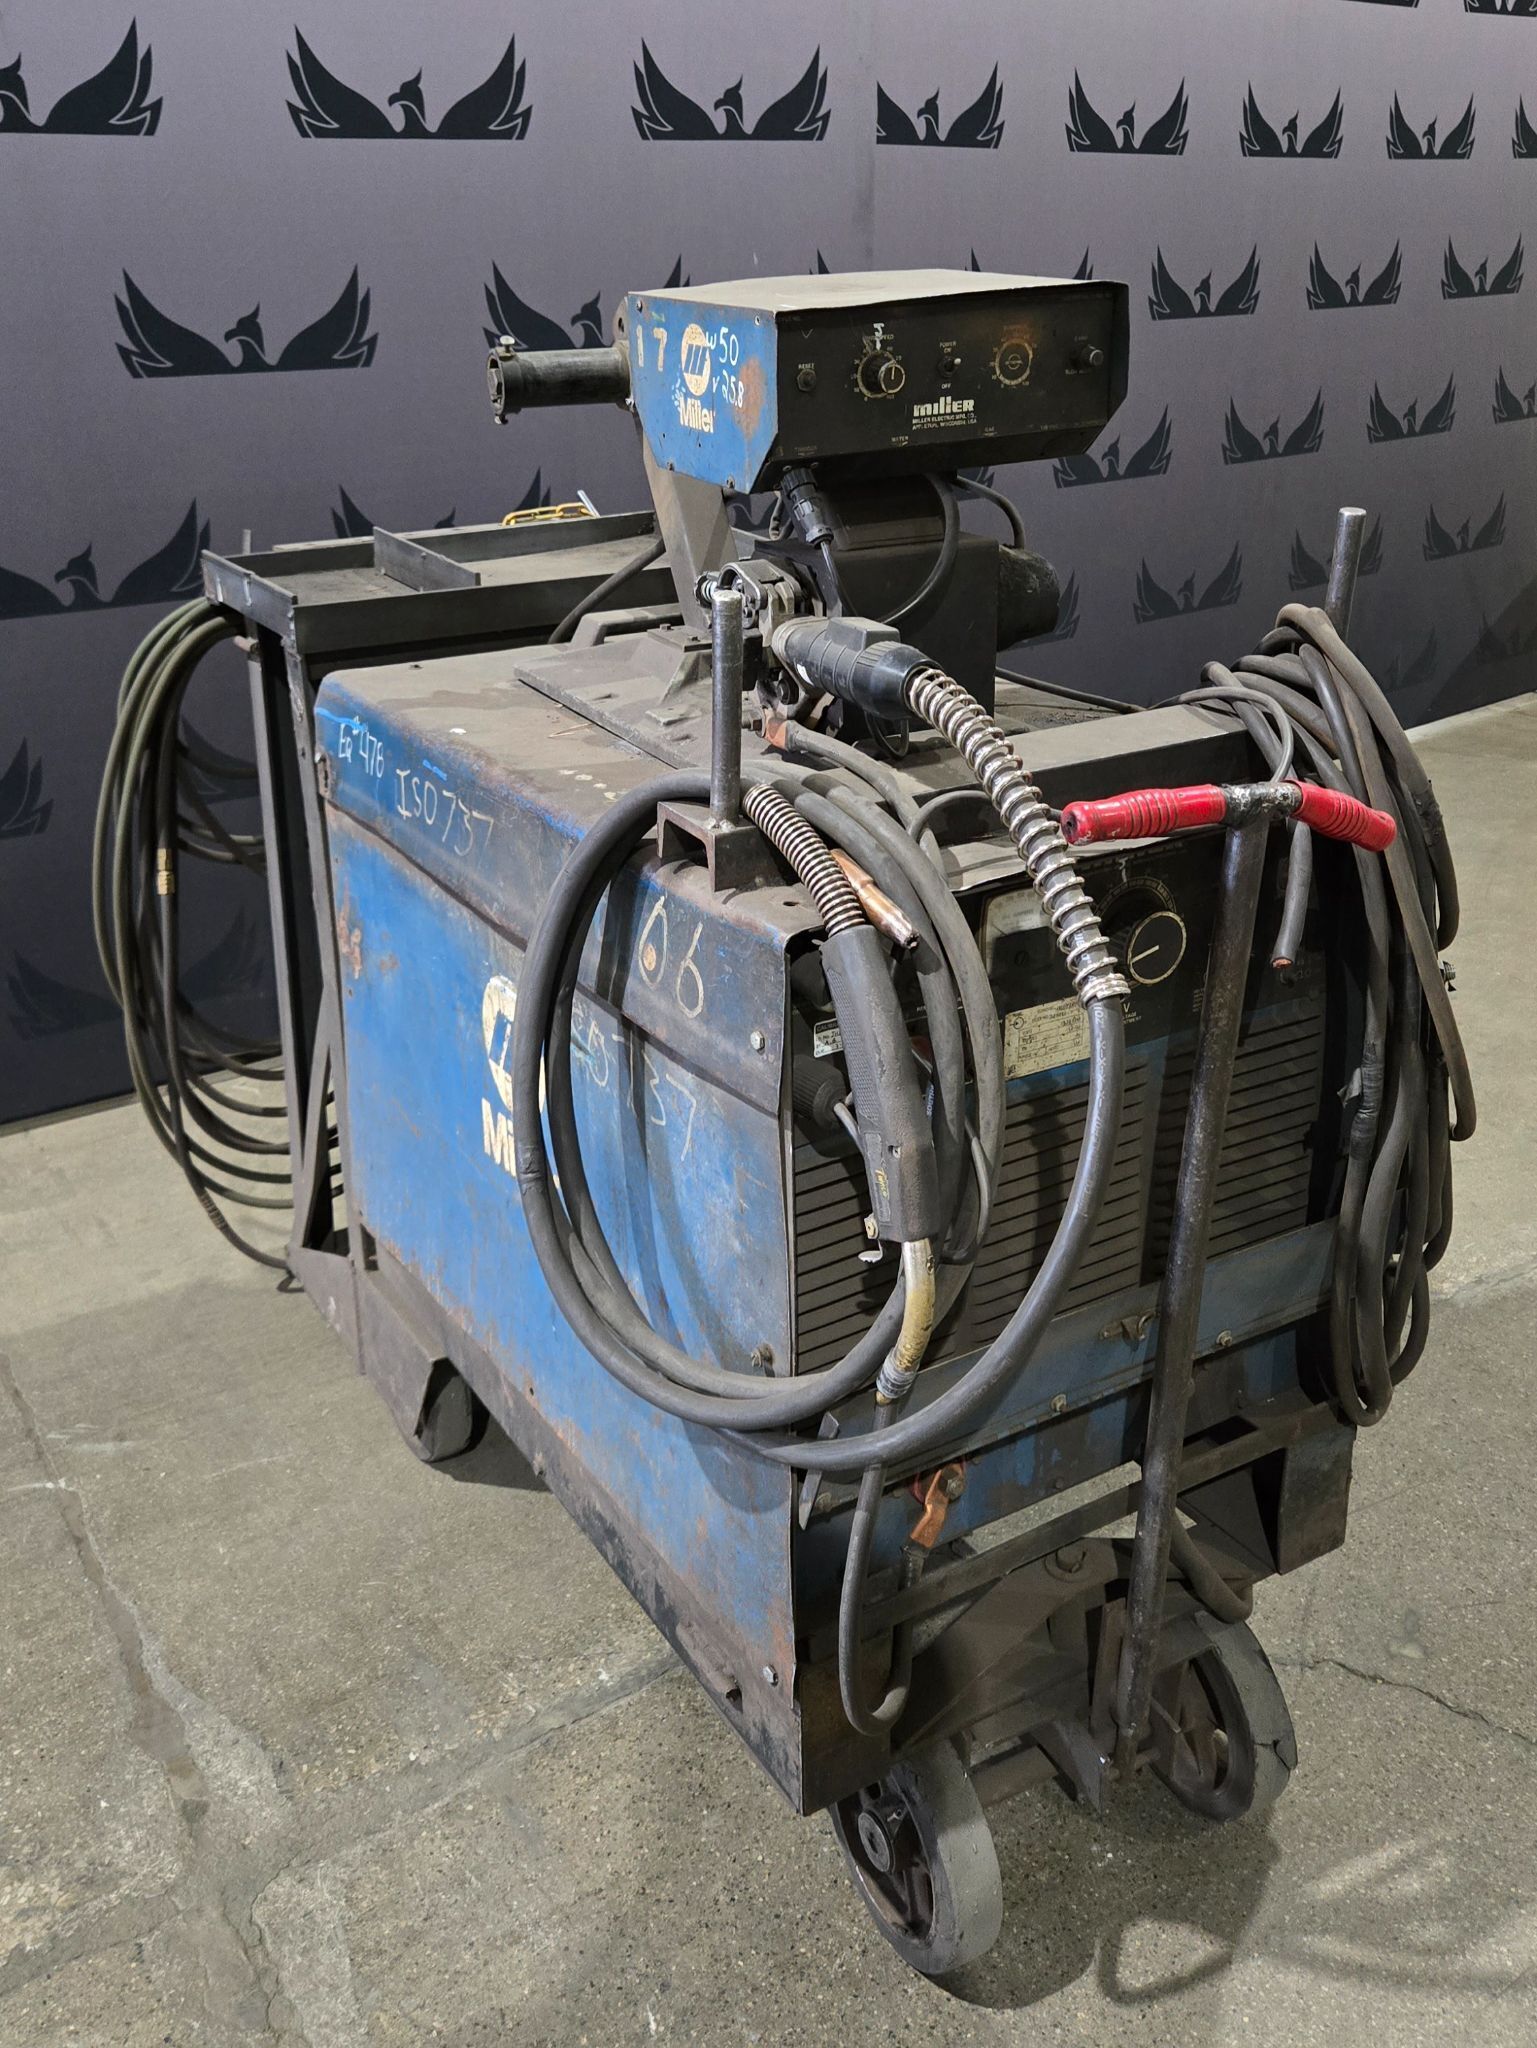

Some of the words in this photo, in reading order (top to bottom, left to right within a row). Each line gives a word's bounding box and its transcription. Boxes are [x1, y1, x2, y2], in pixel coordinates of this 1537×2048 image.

[719, 326, 739, 366] 50
[679, 395, 715, 433] Miller
[931, 414, 955, 422] ELECTRIC
[396, 768, 437, 825] ISO
[442, 790, 494, 856] 737
